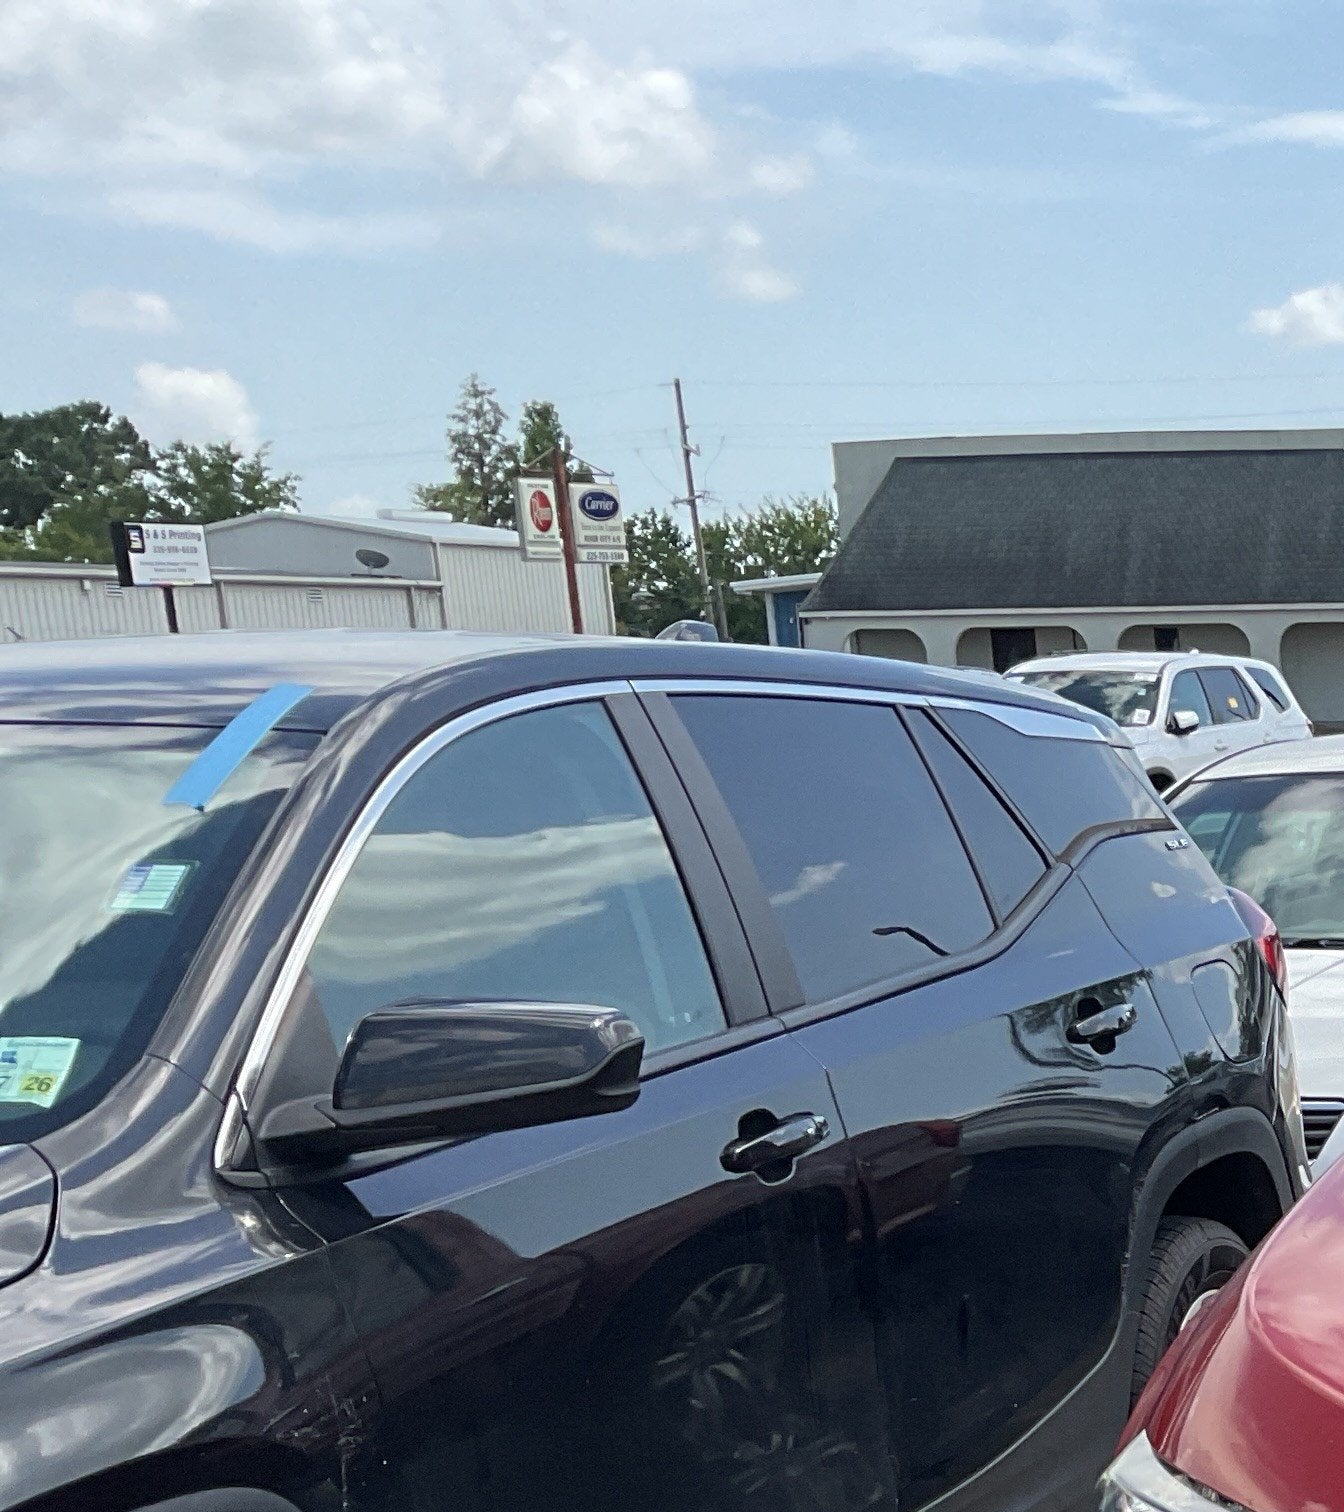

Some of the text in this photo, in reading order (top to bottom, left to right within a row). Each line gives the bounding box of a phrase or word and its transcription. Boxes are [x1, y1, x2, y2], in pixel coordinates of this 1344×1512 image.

[585, 496, 614, 511] Carrier
[144, 530, 151, 539] S
[161, 530, 167, 539] S
[169, 530, 201, 541] Printing
[21, 1076, 53, 1092] 26
